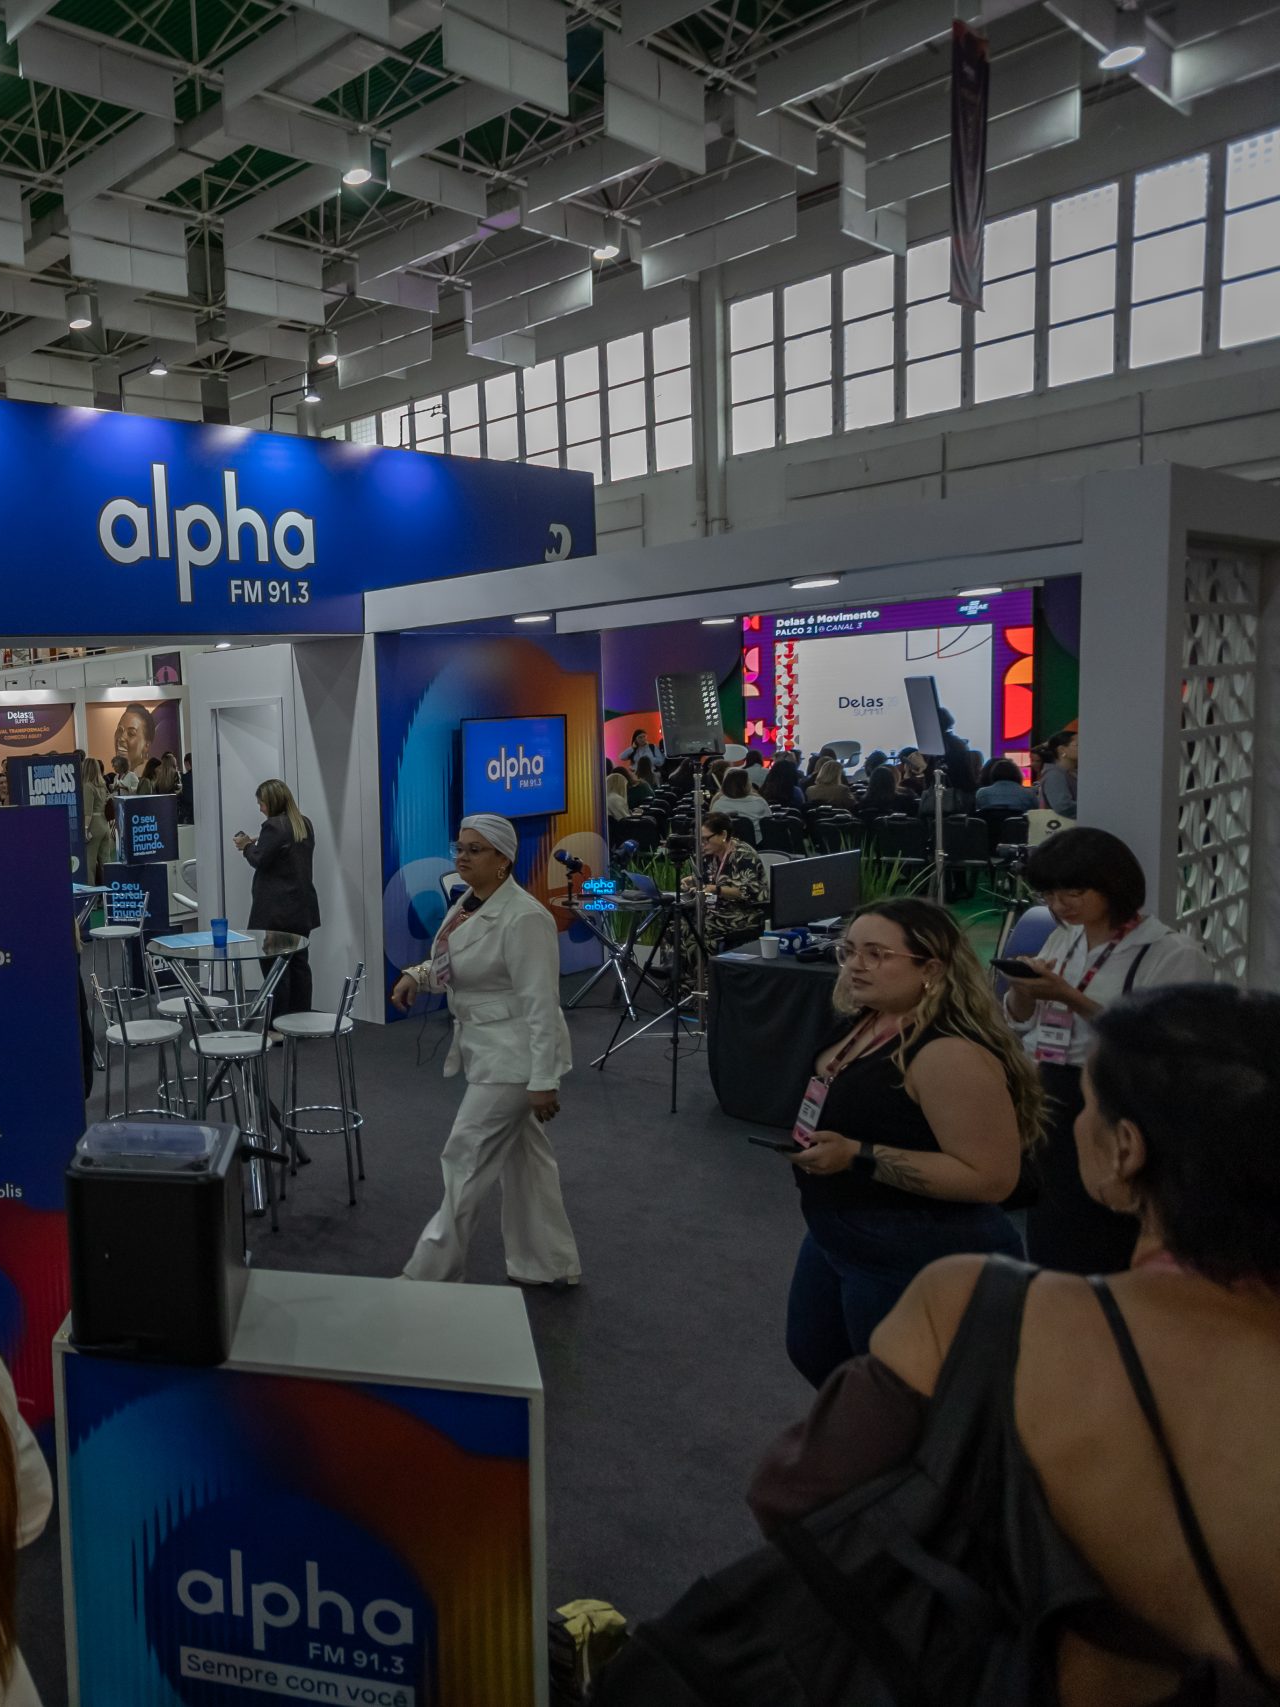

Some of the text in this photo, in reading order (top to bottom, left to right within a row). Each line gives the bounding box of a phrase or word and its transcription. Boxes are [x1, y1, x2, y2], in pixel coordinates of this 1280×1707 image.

[99, 463, 316, 603] alpha
[230, 579, 310, 604] FM 91.3
[776, 610, 880, 628] Delas é Movimento
[775, 627, 805, 636] PALCO
[825, 622, 854, 632] CANAL
[838, 695, 884, 709] Delas
[7, 711, 28, 719] Delas
[488, 745, 544, 790] alpha
[131, 814, 156, 825] O seu
[132, 821, 158, 835] portal
[132, 832, 160, 845] para o
[133, 840, 165, 852] mundo.
[111, 881, 140, 891] O seu
[583, 878, 614, 892] alpha
[112, 889, 143, 902] portal
[176, 1548, 414, 1651] alpha
[308, 1641, 405, 1675] FM 91.3
[187, 1654, 408, 1707] Sempre com você
